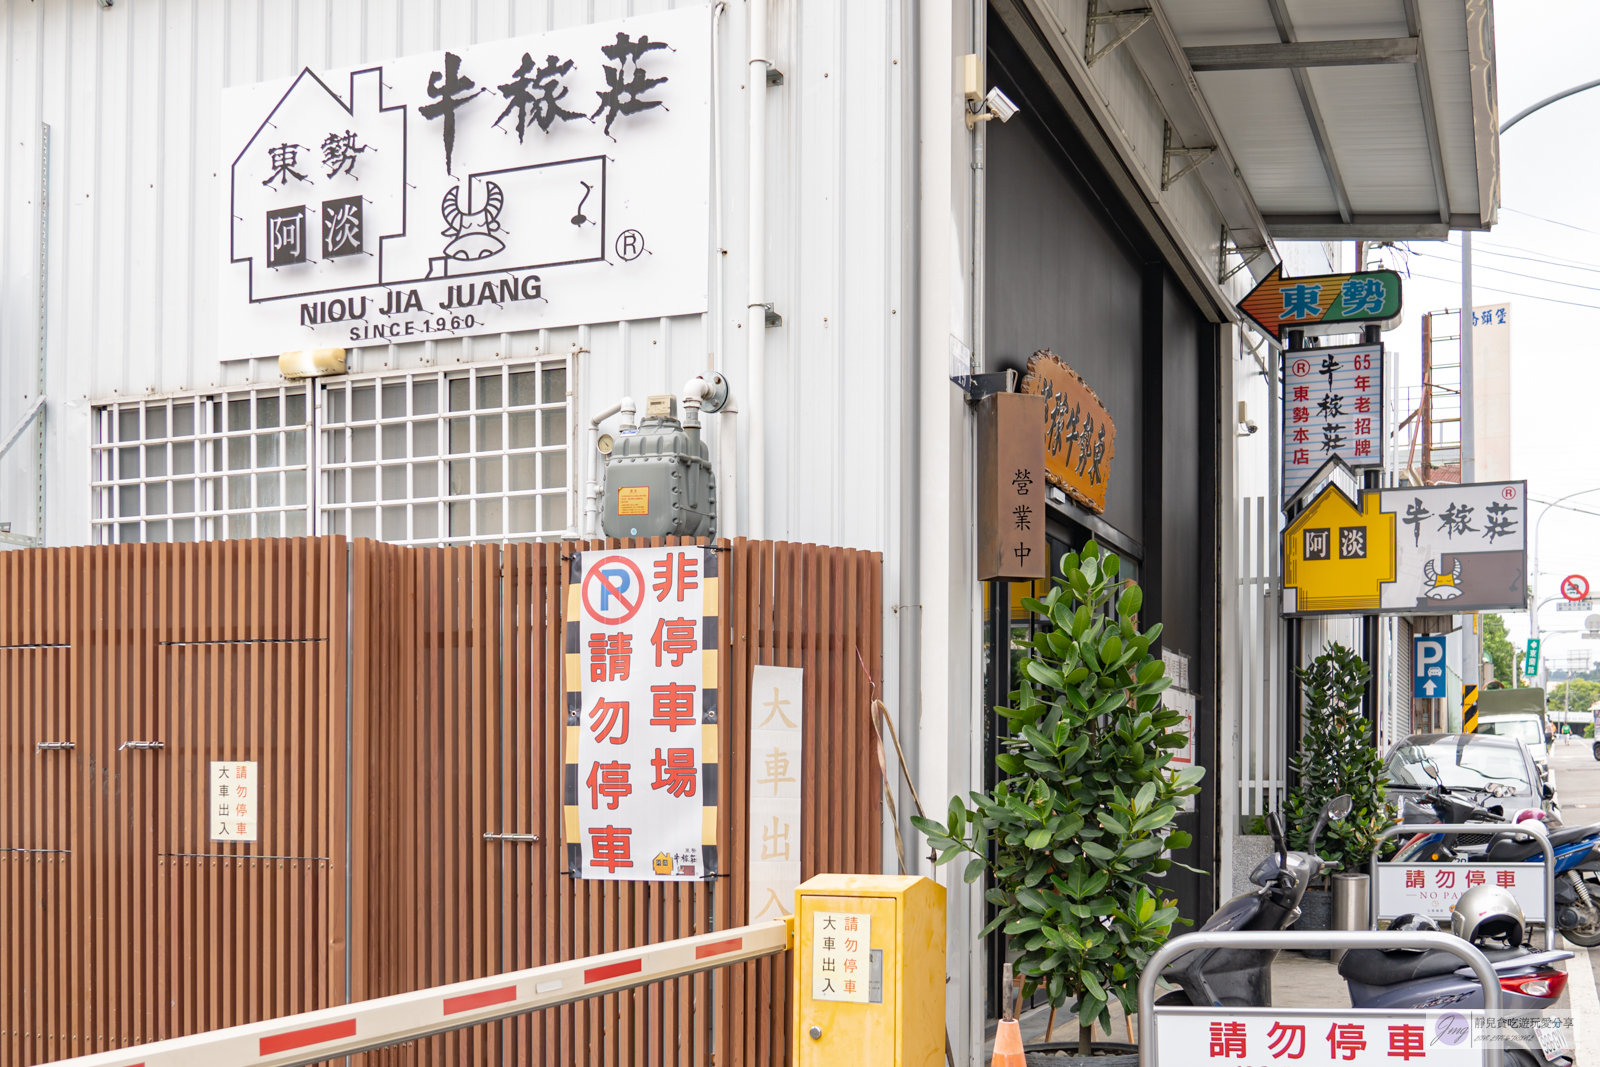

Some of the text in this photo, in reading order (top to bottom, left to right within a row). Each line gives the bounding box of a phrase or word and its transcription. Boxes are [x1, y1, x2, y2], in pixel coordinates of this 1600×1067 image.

[418, 32, 670, 176] 牛稼莊
[263, 130, 367, 186] 東勢
[268, 198, 362, 265] 阿淡
[300, 275, 542, 326] NIOU JIA JUANG
[350, 314, 476, 341] SINCE 1960
[1279, 278, 1386, 320] 東勢
[1292, 386, 1310, 465] 東勢本店
[1316, 353, 1349, 456] 牛稼莊
[1011, 468, 1033, 568] 營業中
[1304, 528, 1366, 559] 阿淡
[1402, 497, 1519, 548] 牛稼莊
[650, 552, 699, 799] 非停車場
[586, 632, 635, 874] 請勿停車
[218, 765, 230, 836] 大車出入
[236, 765, 248, 836] 請勿停車
[755, 687, 799, 920] 大車出入
[1405, 869, 1517, 889] 請勿停車
[1420, 891, 1438, 900] NO
[821, 915, 837, 994] 大車出入
[843, 916, 859, 995] 請勿停車
[1209, 1020, 1427, 1062] 請勿停車
